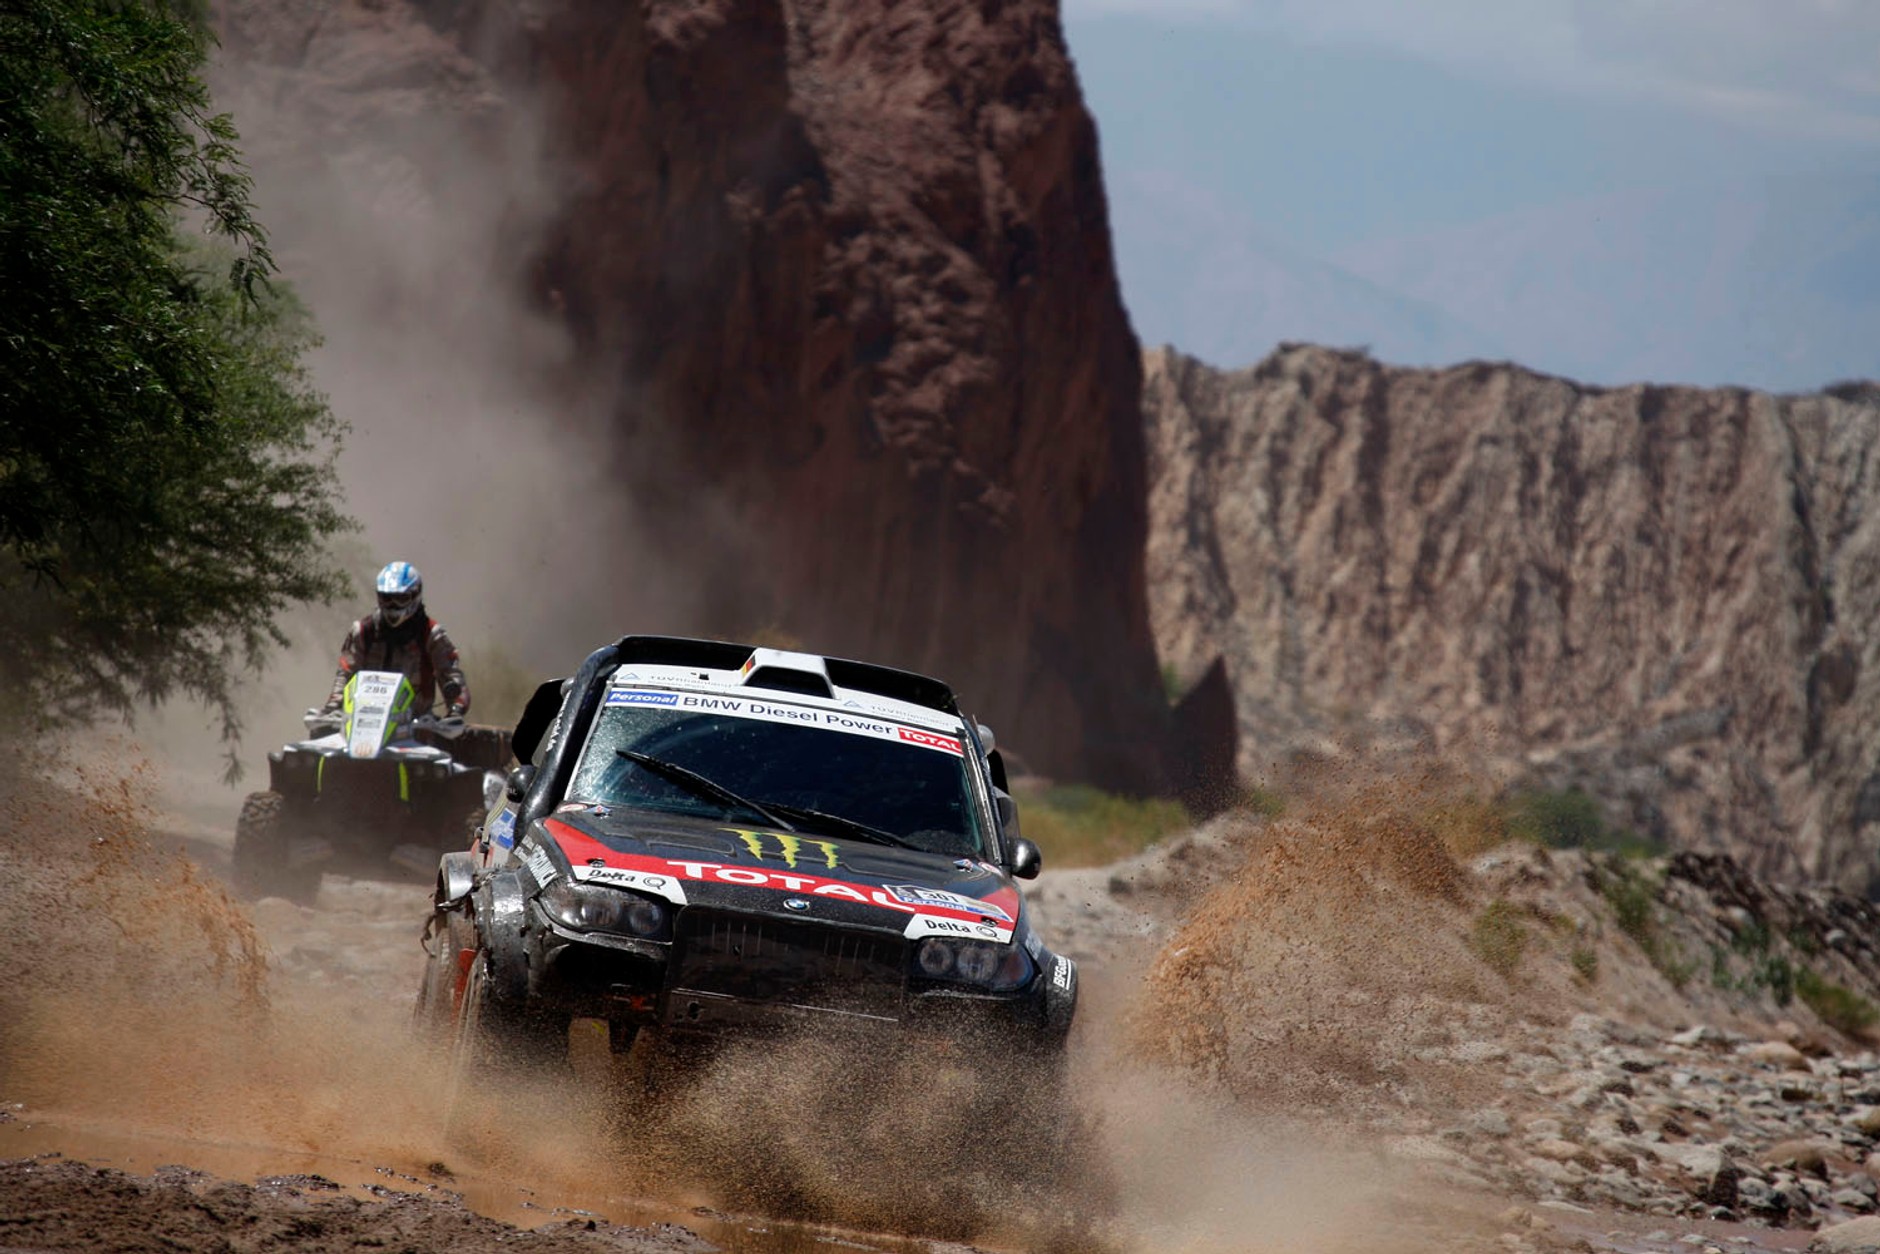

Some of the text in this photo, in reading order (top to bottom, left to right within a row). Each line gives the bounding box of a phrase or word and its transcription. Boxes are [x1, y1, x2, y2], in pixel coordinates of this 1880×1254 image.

[609, 692, 677, 704] Personal
[683, 697, 742, 711] BMW
[749, 704, 818, 722] Diesel
[826, 714, 893, 734] Power
[902, 729, 962, 750] TOTAL
[588, 869, 636, 882] Delta
[667, 860, 916, 912] TOTAL
[922, 891, 960, 903] 301
[924, 919, 972, 933] Delta
